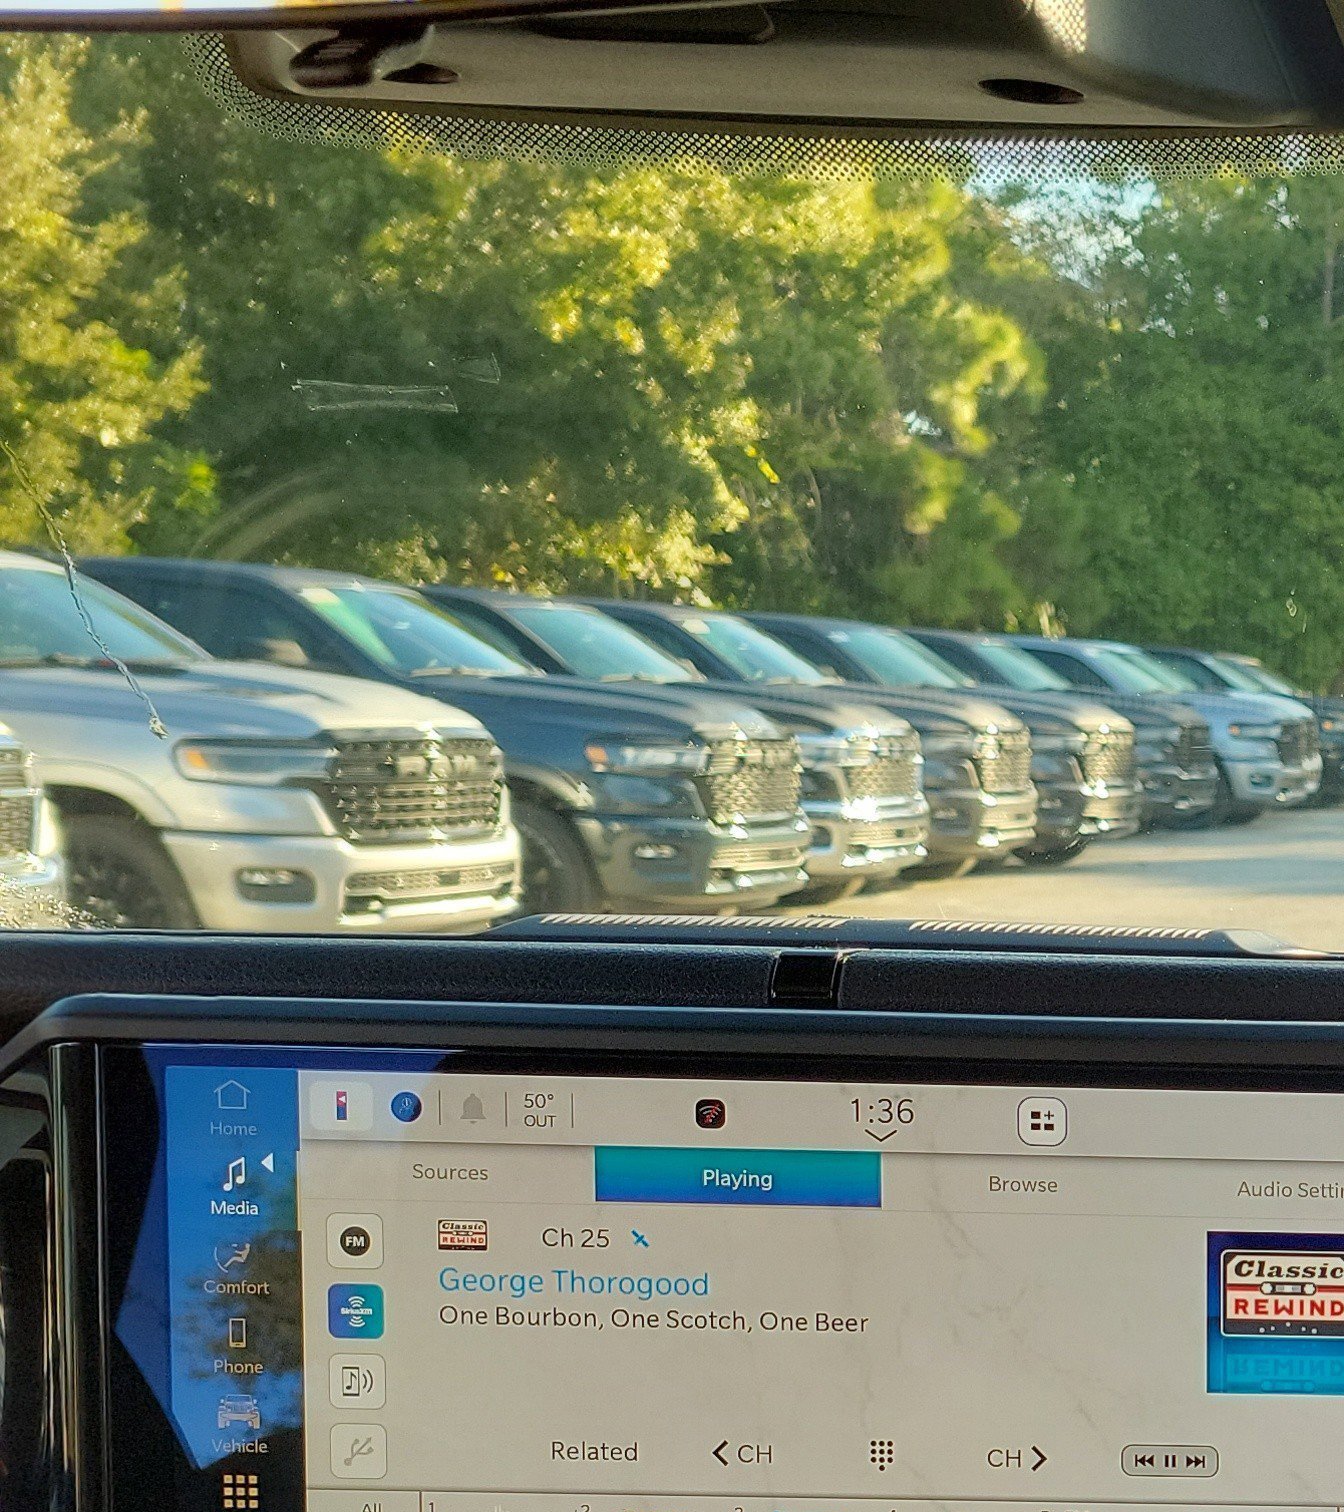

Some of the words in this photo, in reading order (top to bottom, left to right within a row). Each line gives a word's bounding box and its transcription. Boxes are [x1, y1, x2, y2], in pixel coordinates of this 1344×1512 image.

[523, 1093, 554, 1109] 50°
[523, 1114, 556, 1128] OUT
[850, 1098, 914, 1126] 1:36
[210, 1121, 258, 1136] Home
[412, 1163, 488, 1181] Sources
[702, 1168, 773, 1192] Playing
[988, 1174, 1058, 1195] Browse
[1237, 1180, 1293, 1200] Audio
[211, 1200, 259, 1216] Media
[345, 1235, 365, 1247] FM
[542, 1228, 573, 1248] Ch
[581, 1229, 610, 1248] 25
[1234, 1259, 1344, 1279] Classic
[204, 1280, 270, 1295] Comfort
[439, 1267, 544, 1297] George
[552, 1270, 709, 1300] Thorogood
[439, 1305, 488, 1325] One
[496, 1306, 604, 1330] Bourbon,
[611, 1308, 660, 1329] One
[666, 1309, 753, 1333] Scotch,
[759, 1311, 809, 1331] One
[815, 1312, 869, 1333] Beer
[214, 1359, 264, 1375] Phone
[211, 1438, 268, 1454] Vehicle
[551, 1441, 638, 1461] Related
[738, 1445, 773, 1463] CH
[987, 1449, 1021, 1468] CH
